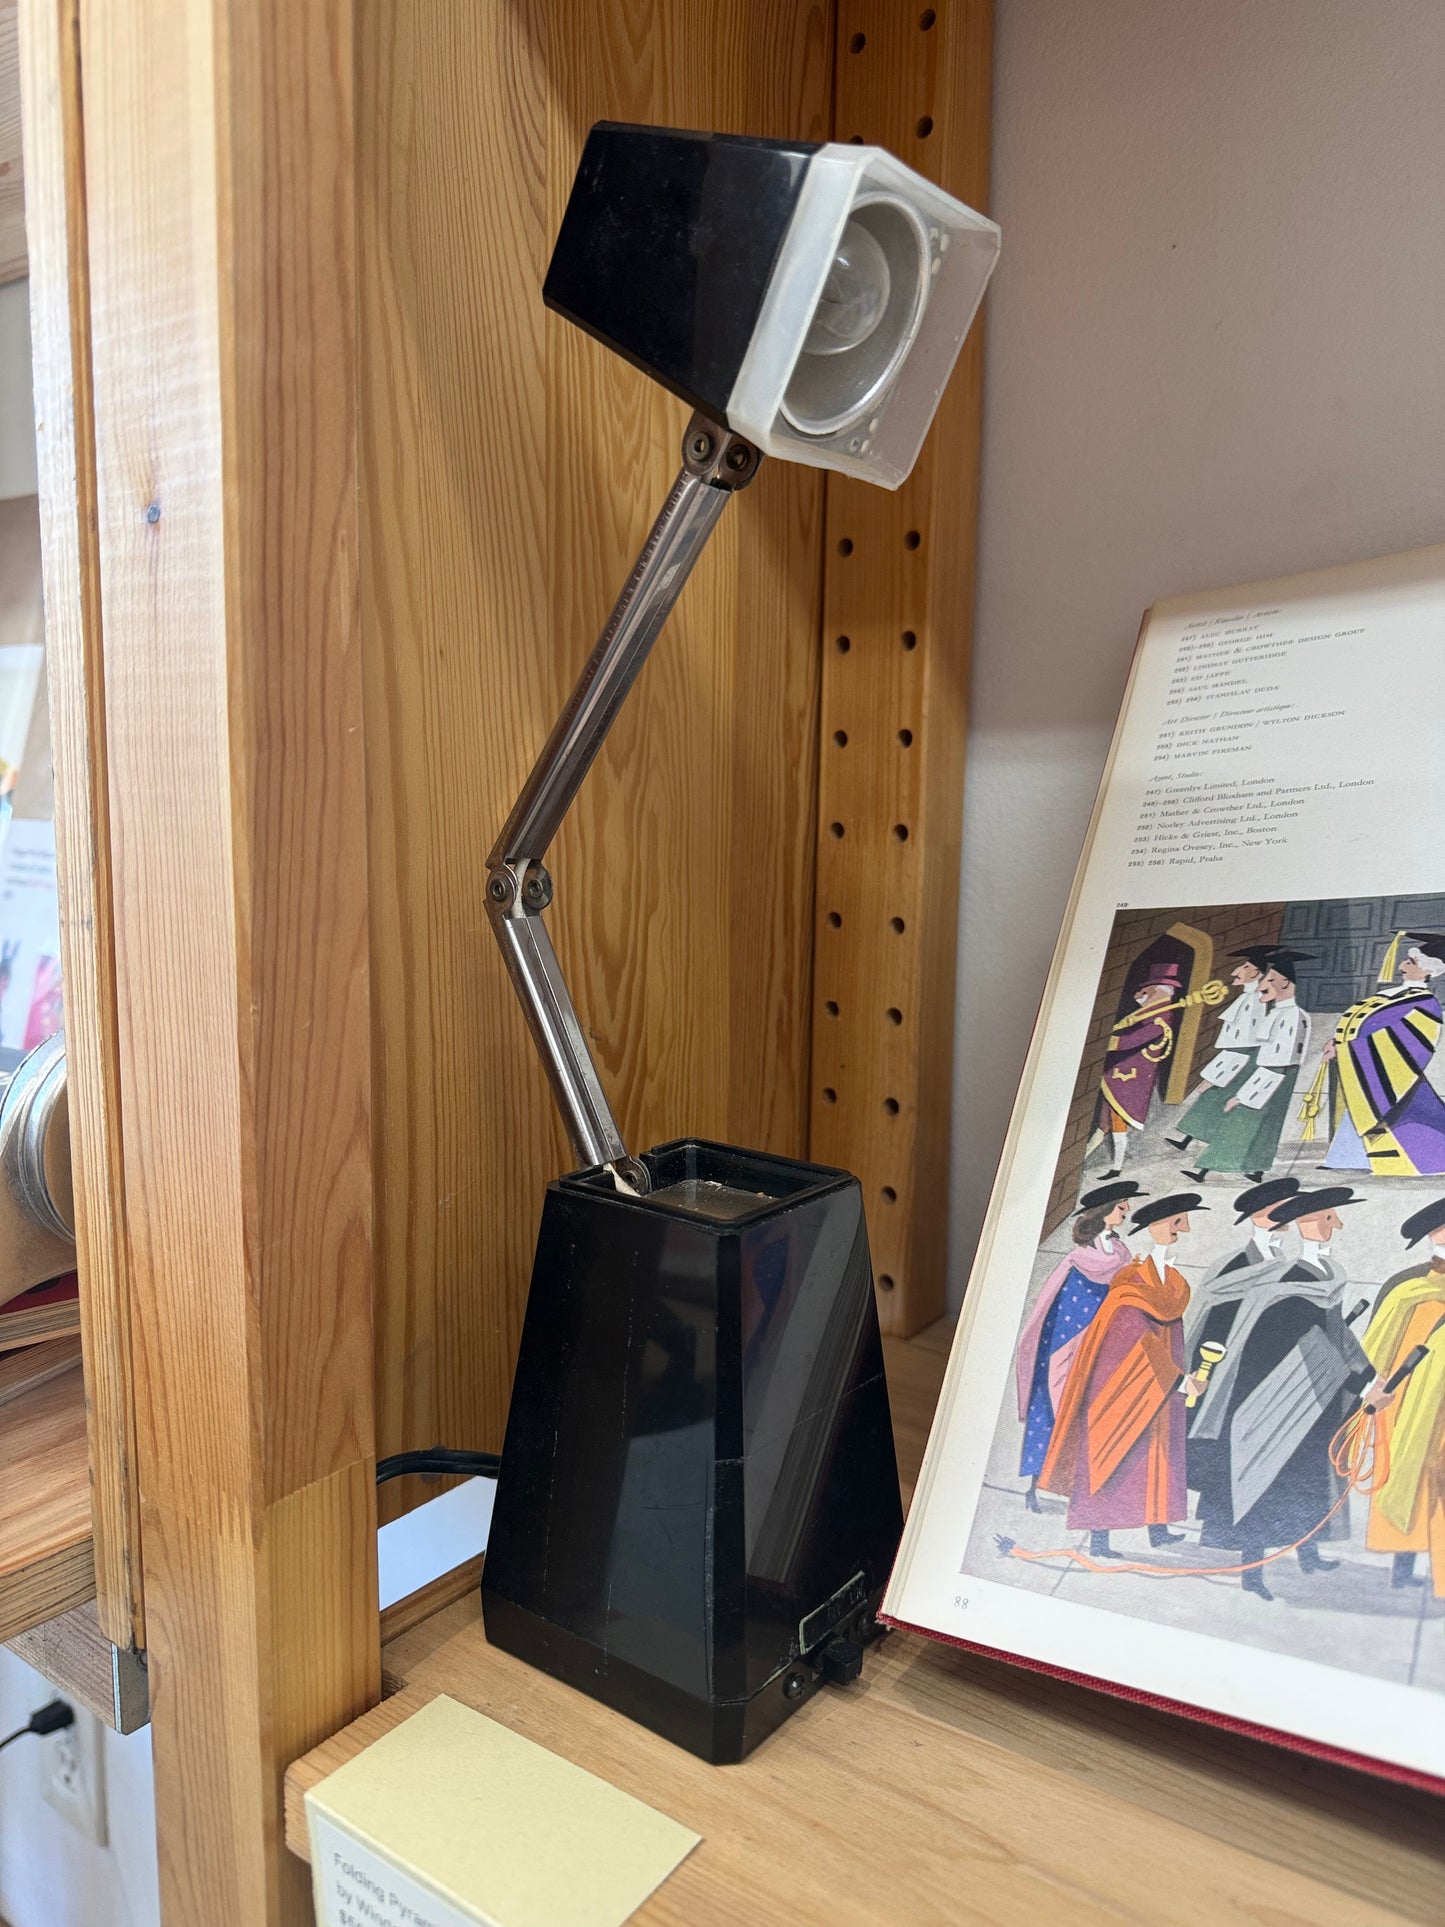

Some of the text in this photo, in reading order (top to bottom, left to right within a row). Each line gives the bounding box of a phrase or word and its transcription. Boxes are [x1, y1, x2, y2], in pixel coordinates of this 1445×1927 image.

[1298, 633, 1332, 644] DESIGN
[1335, 627, 1366, 638] GROUP
[1304, 710, 1346, 721] DICKSON
[1176, 740, 1199, 749] DICK
[1201, 735, 1240, 745] NATHAN
[1203, 779, 1238, 791] Limited,
[1241, 776, 1275, 787] London
[1216, 791, 1254, 802] Bloxham
[1256, 788, 1273, 797] and
[1275, 785, 1312, 795] Partners
[1338, 777, 1375, 788] London
[1160, 809, 1189, 818] Mather
[1203, 803, 1244, 814] Crowther
[1270, 798, 1305, 808] London
[1156, 821, 1185, 830] Notley
[1187, 816, 1237, 828] Advertising
[1263, 811, 1298, 820] London
[1153, 833, 1178, 842] Hicks
[1180, 832, 1189, 840] &
[1246, 825, 1277, 835] Boston
[1151, 845, 1180, 855] Regina
[1241, 839, 1262, 847] New
[1264, 836, 1288, 845] York
[1168, 856, 1196, 866] Rapid,
[1199, 854, 1223, 863] Praha
[954, 1596, 969, 1610] 88
[333, 1852, 385, 1903] Folding
[336, 1879, 353, 1905] by
